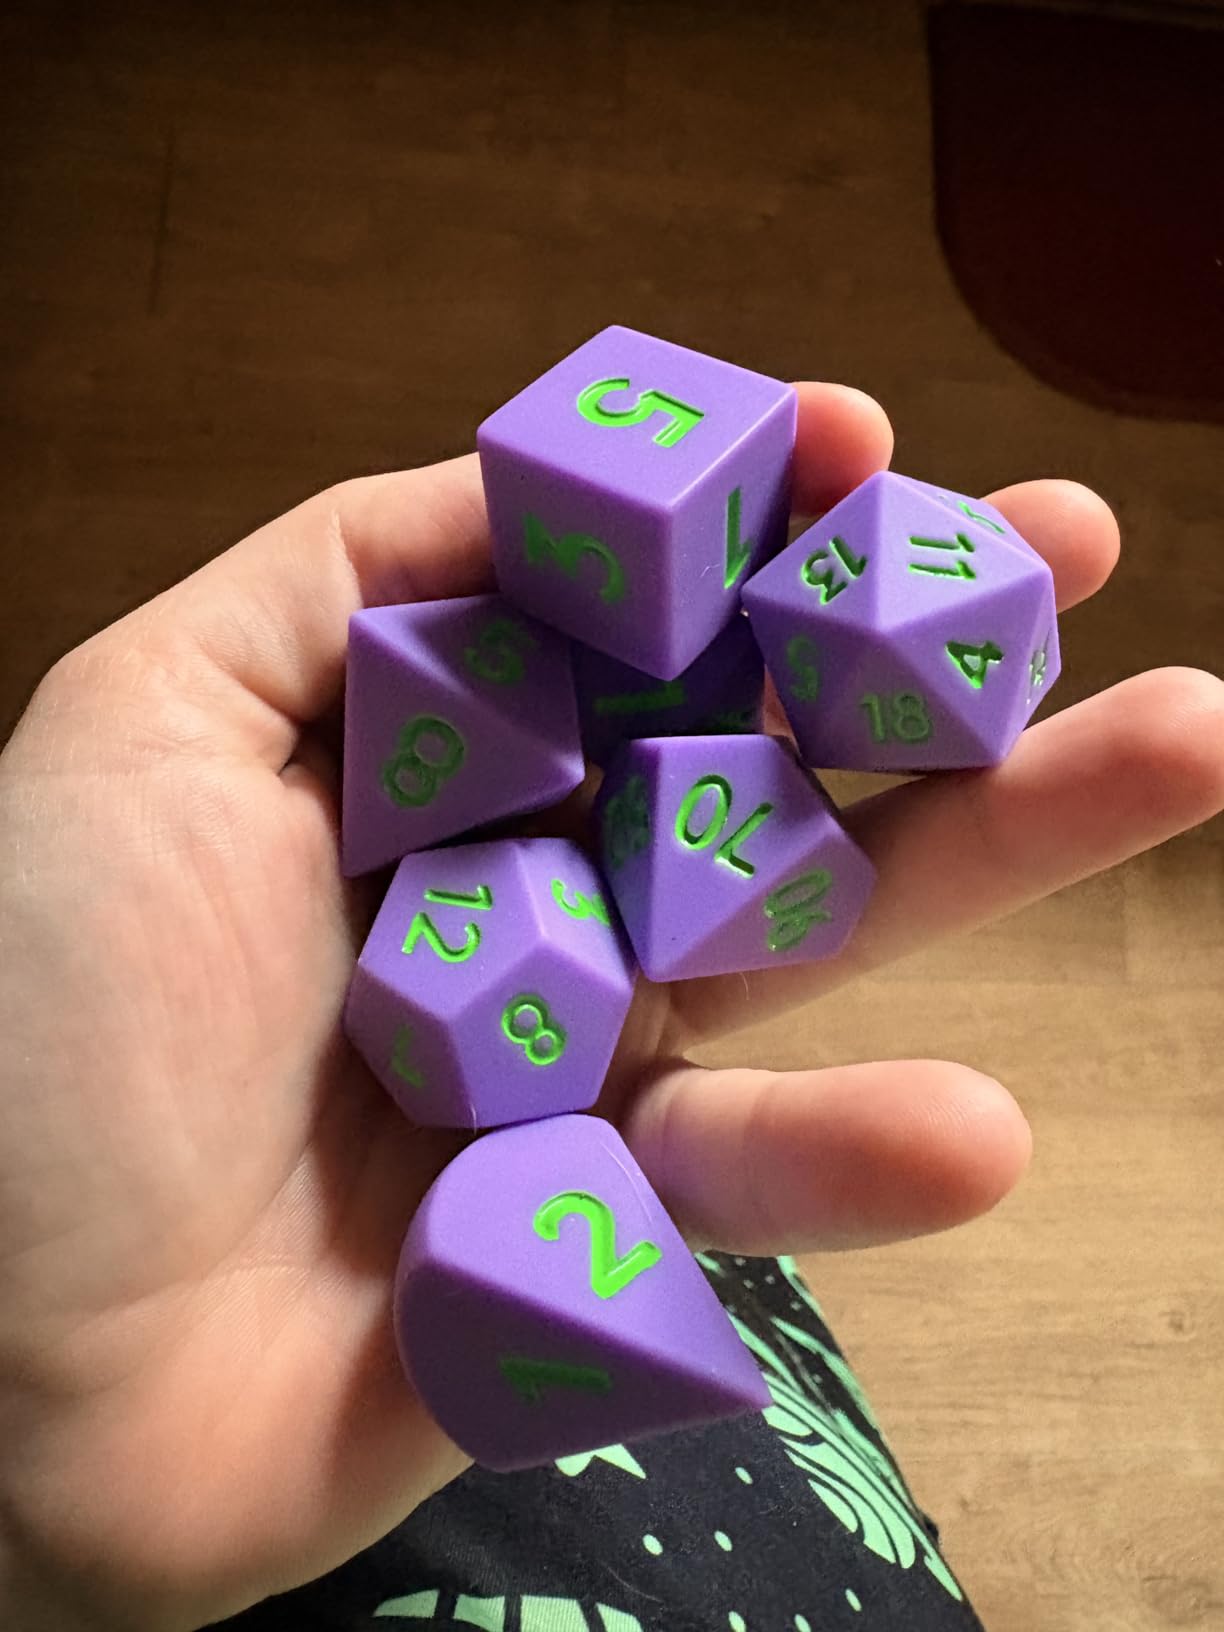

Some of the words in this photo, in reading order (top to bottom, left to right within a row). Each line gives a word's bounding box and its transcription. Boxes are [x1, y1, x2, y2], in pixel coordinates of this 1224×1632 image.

[575, 377, 706, 449] 5
[521, 511, 626, 606] 3
[723, 485, 752, 591] 1
[799, 535, 868, 607] 13
[906, 532, 977, 582] 11
[943, 639, 1004, 690] 4
[859, 692, 934, 744] 18
[380, 712, 467, 808] 8
[674, 773, 775, 880] 70
[400, 884, 495, 965] 12
[501, 992, 567, 1067] 8
[532, 1190, 663, 1301] 2
[498, 1353, 615, 1402] 1
